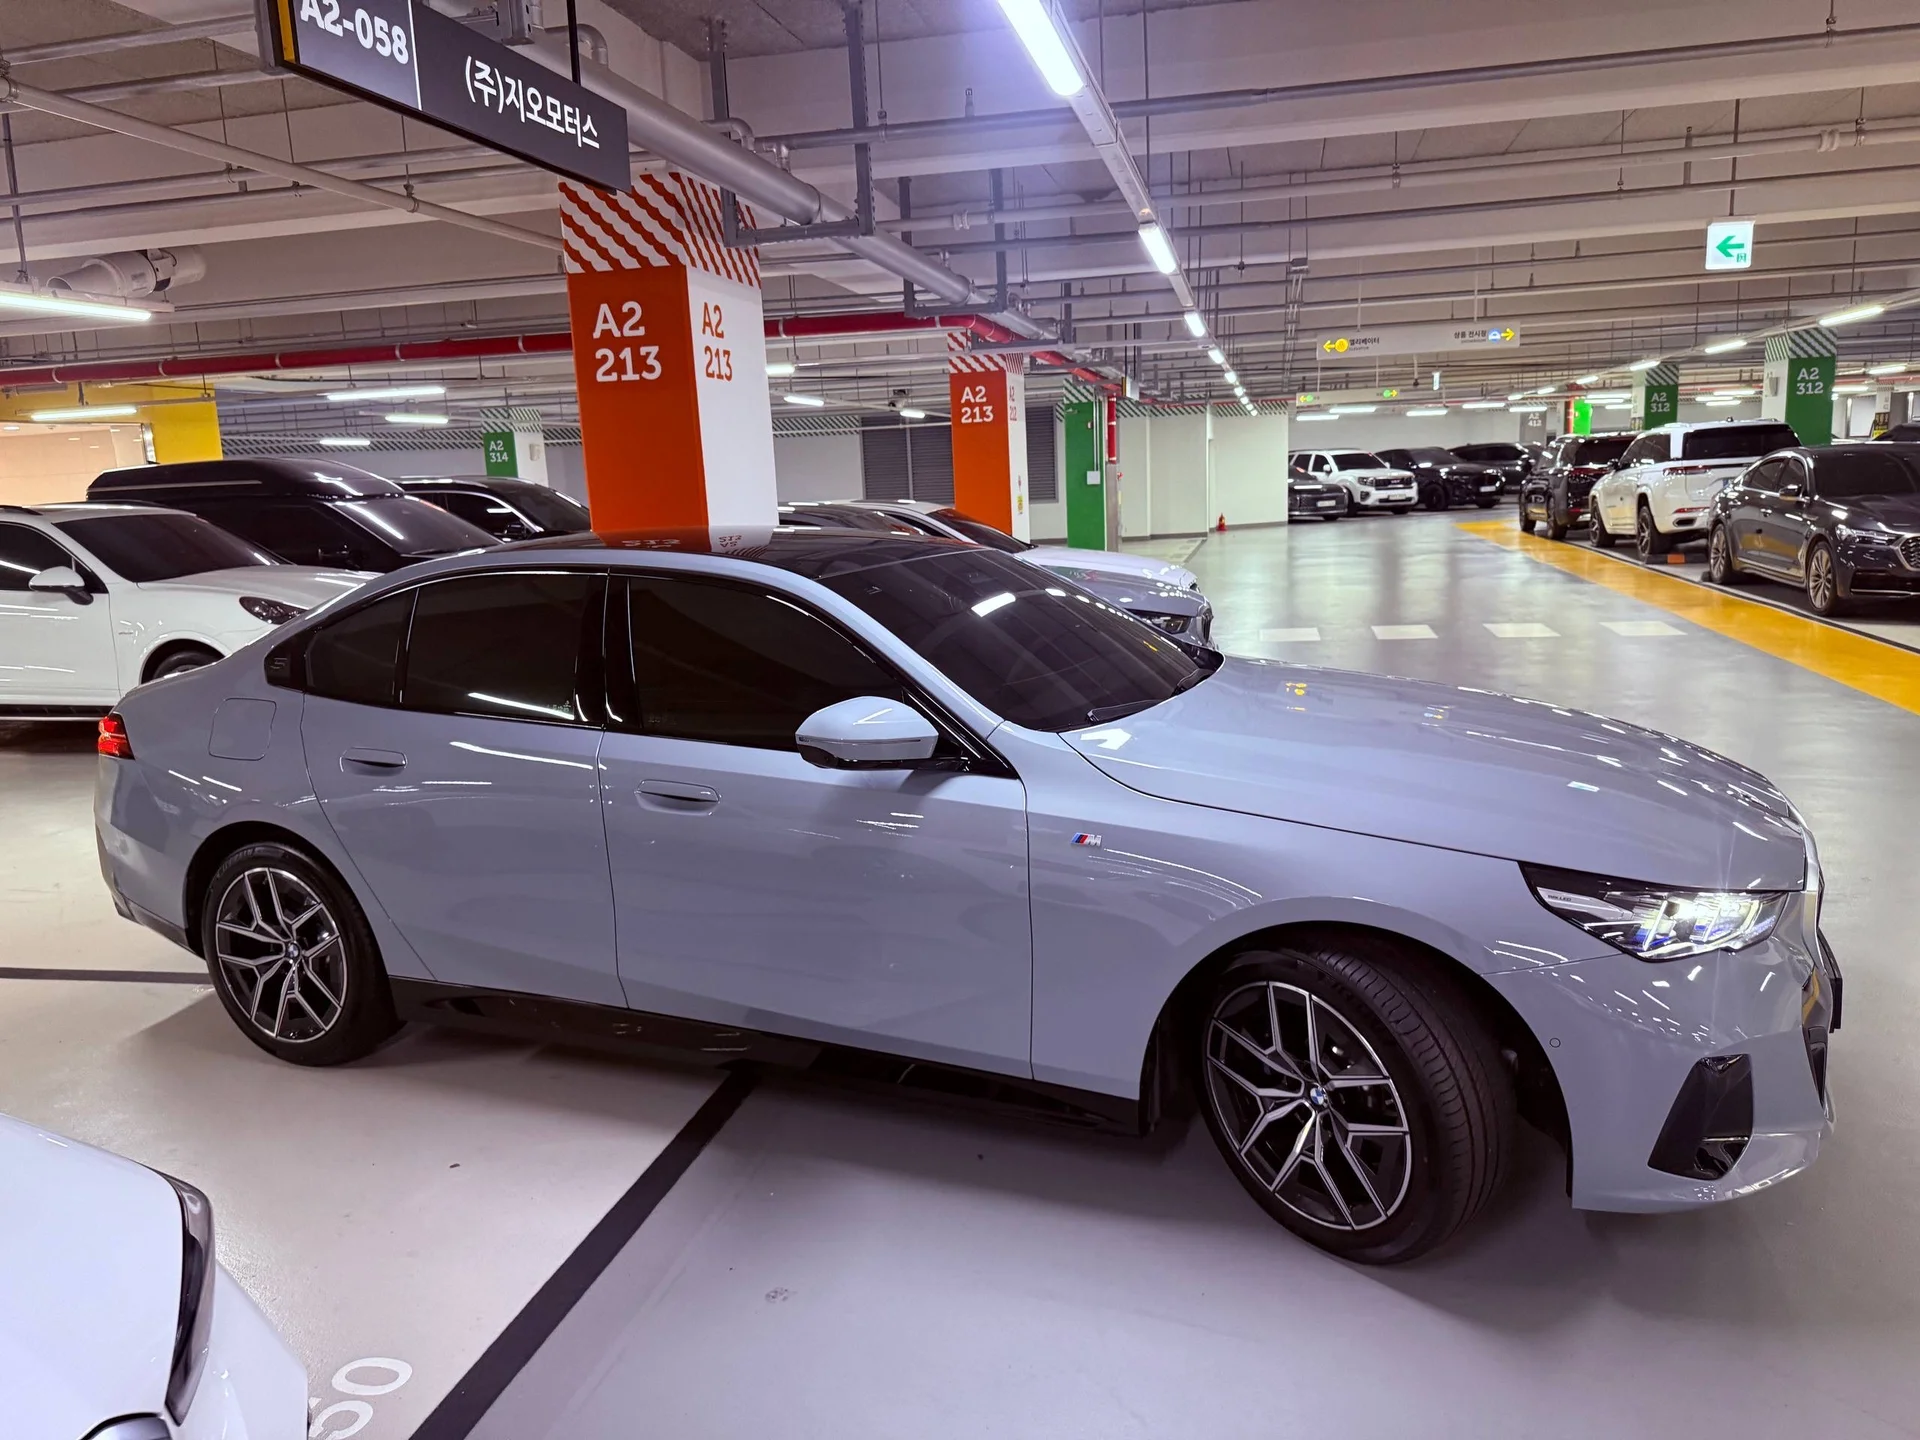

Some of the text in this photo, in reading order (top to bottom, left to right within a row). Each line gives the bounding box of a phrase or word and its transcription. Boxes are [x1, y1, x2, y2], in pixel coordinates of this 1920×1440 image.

[465, 56, 600, 149] (주)지오모터스
[593, 301, 646, 338] A2
[702, 302, 724, 339] A2
[595, 345, 662, 382] 213
[705, 346, 733, 381] 213
[1797, 367, 1819, 380] A2
[960, 386, 987, 404] A2
[1651, 392, 1667, 402] A2
[1796, 382, 1824, 395] 312
[961, 405, 994, 424] 213
[1650, 403, 1670, 412] 312
[489, 441, 504, 451] A2
[490, 452, 509, 463] 314
